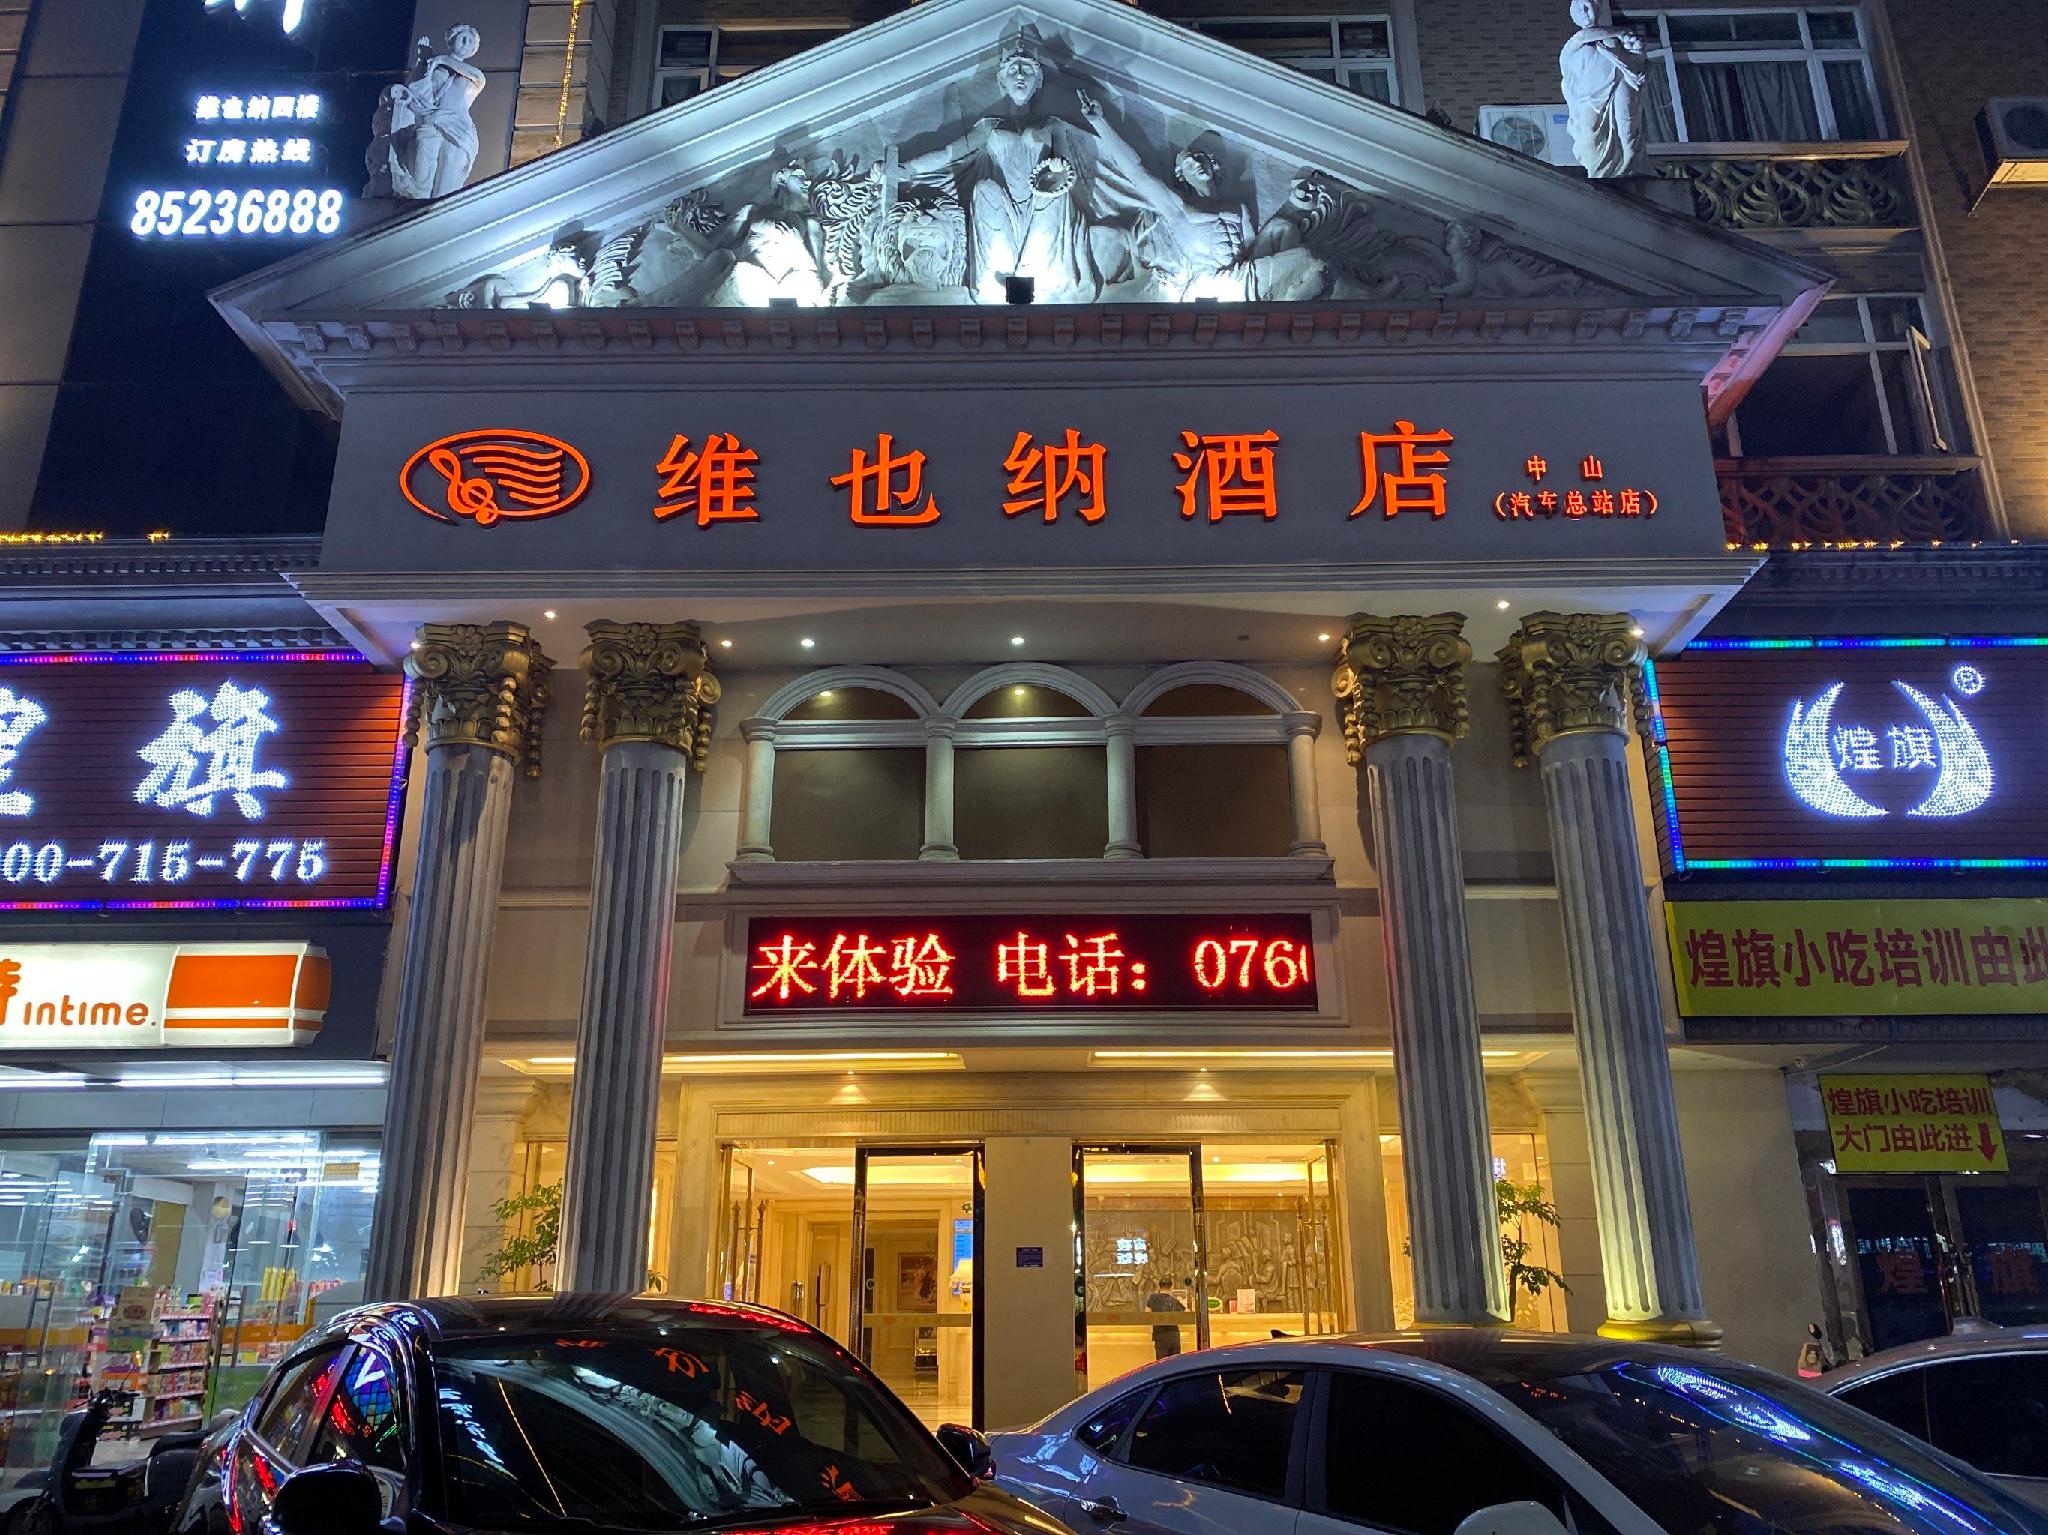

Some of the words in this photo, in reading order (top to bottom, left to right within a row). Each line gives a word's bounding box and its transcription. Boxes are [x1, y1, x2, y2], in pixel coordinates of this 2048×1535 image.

[186, 138, 311, 163] 订房热线
[131, 189, 343, 236] 85236888
[652, 421, 1454, 525] 维也纳酒店
[1527, 454, 1603, 481] 中山
[1833, 724, 1937, 770] 煌旗
[752, 934, 955, 998] 来体验
[24, 995, 149, 1026] intime
[1826, 1087, 1992, 1115] 煌旗小吃培训
[1836, 1123, 1974, 1152] 大门由此进
